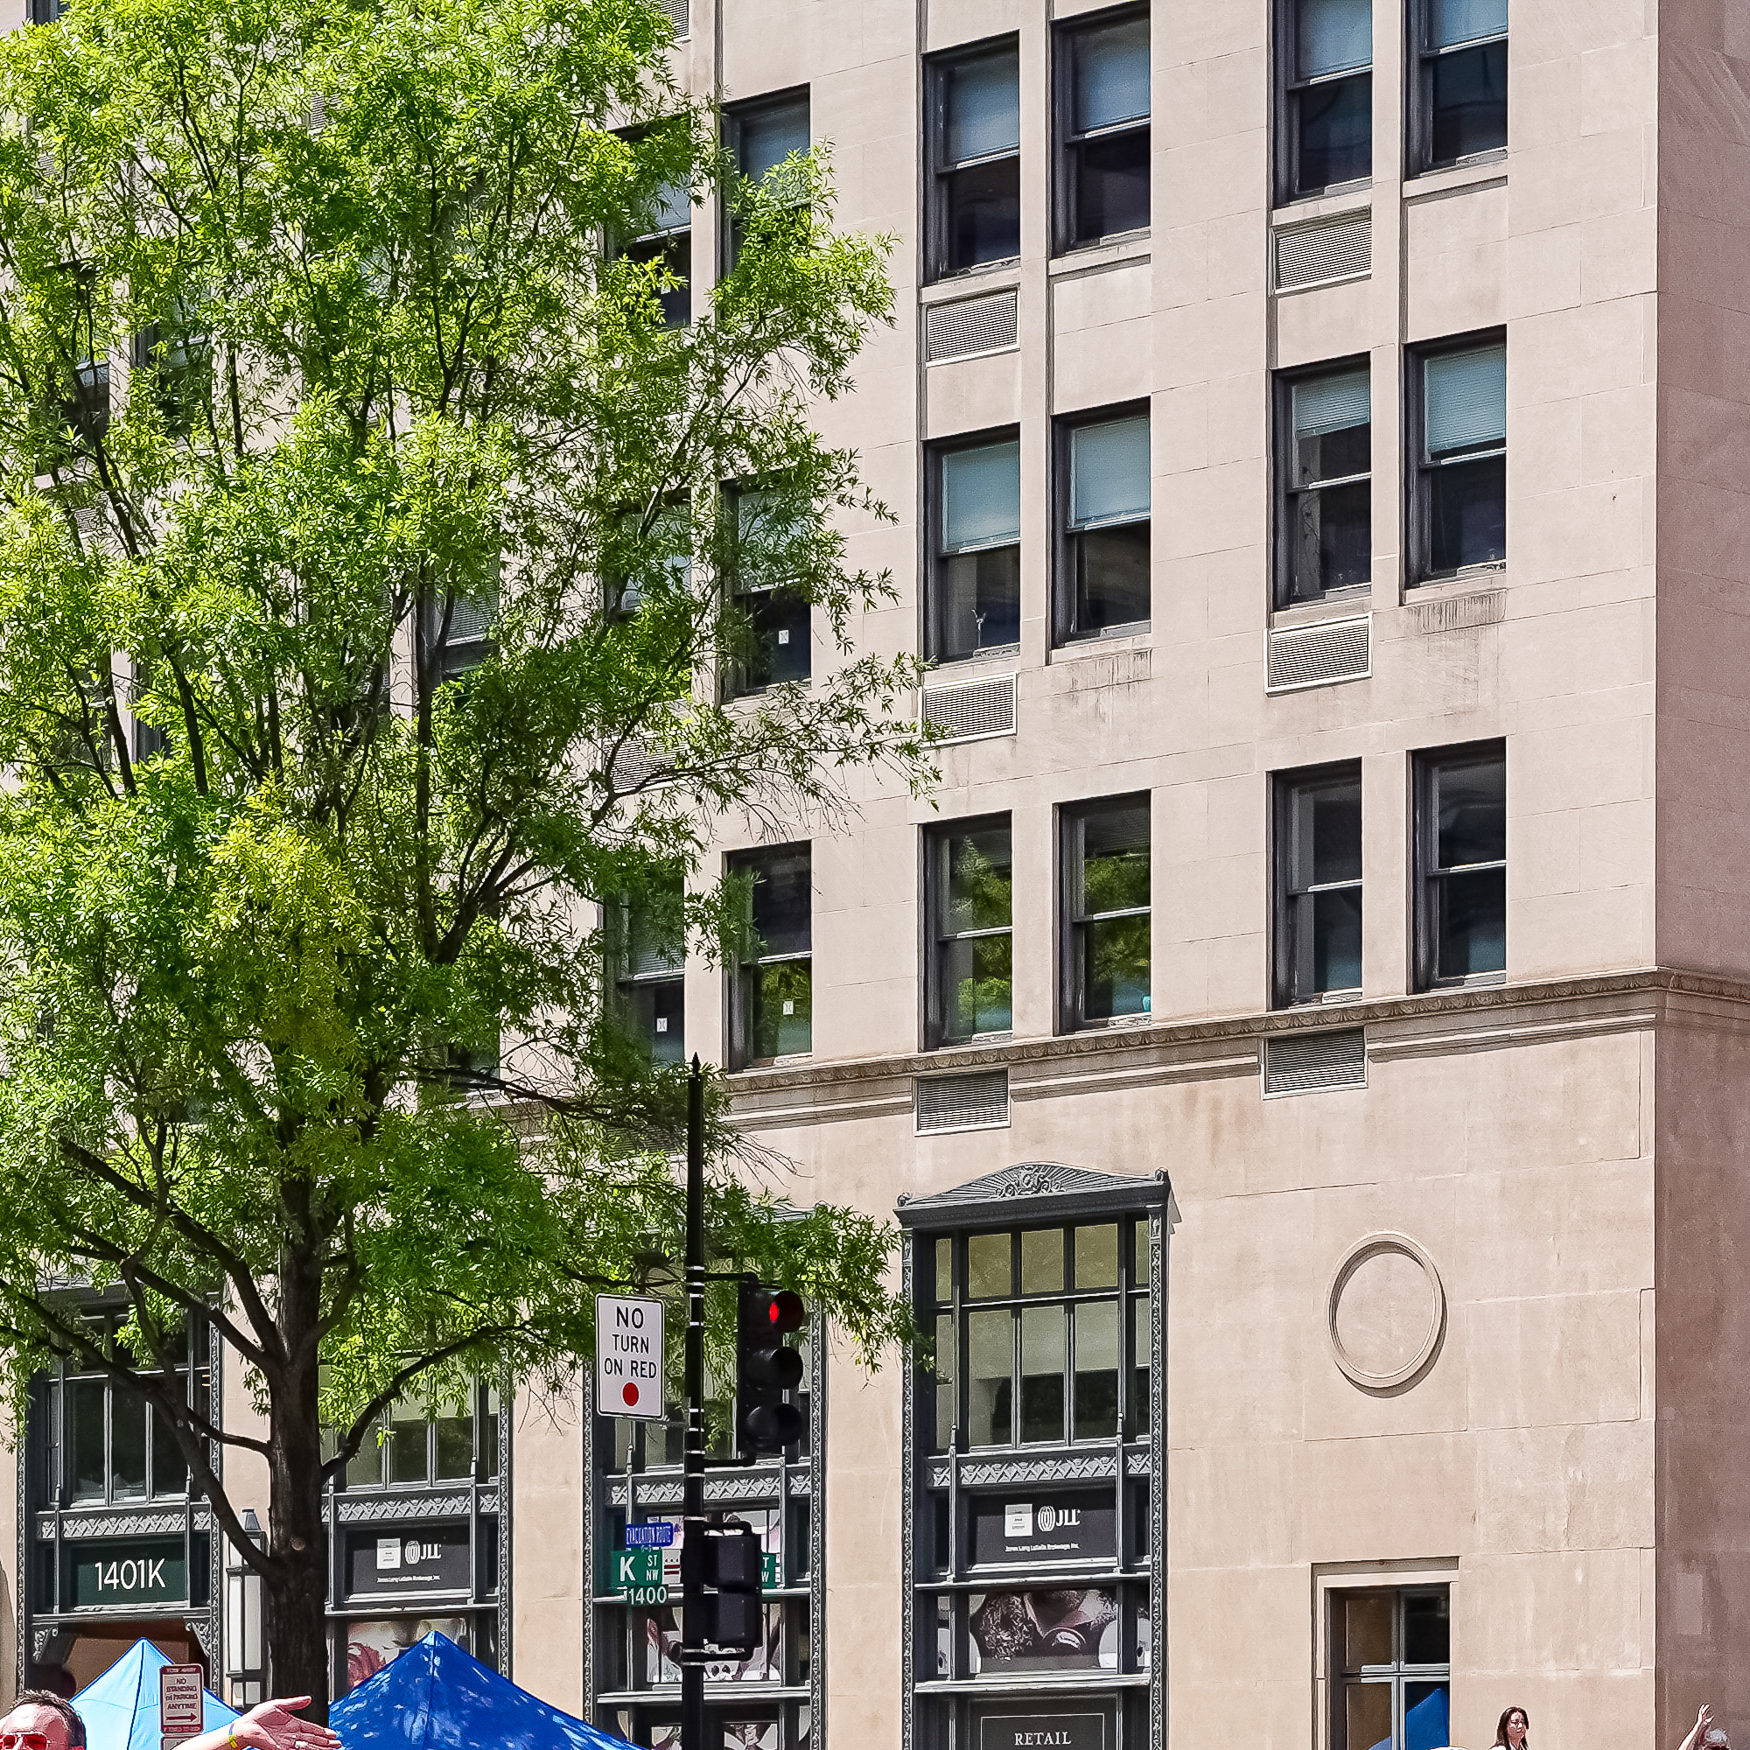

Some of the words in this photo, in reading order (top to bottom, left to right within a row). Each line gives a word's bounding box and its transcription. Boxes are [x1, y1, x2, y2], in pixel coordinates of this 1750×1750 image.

[616, 1306, 644, 1329] NO
[612, 1334, 649, 1354] TURN
[604, 1357, 623, 1376] ON
[630, 1359, 657, 1379] RED
[1056, 1508, 1081, 1527] JLL
[619, 1556, 636, 1582] K
[647, 1554, 658, 1567] ST
[762, 1556, 770, 1568] T
[95, 1558, 166, 1591] 1401K
[646, 1569, 659, 1582] NW
[761, 1571, 770, 1582] W
[629, 1586, 667, 1605] 1400
[1014, 1731, 1071, 1746] RETAIL
